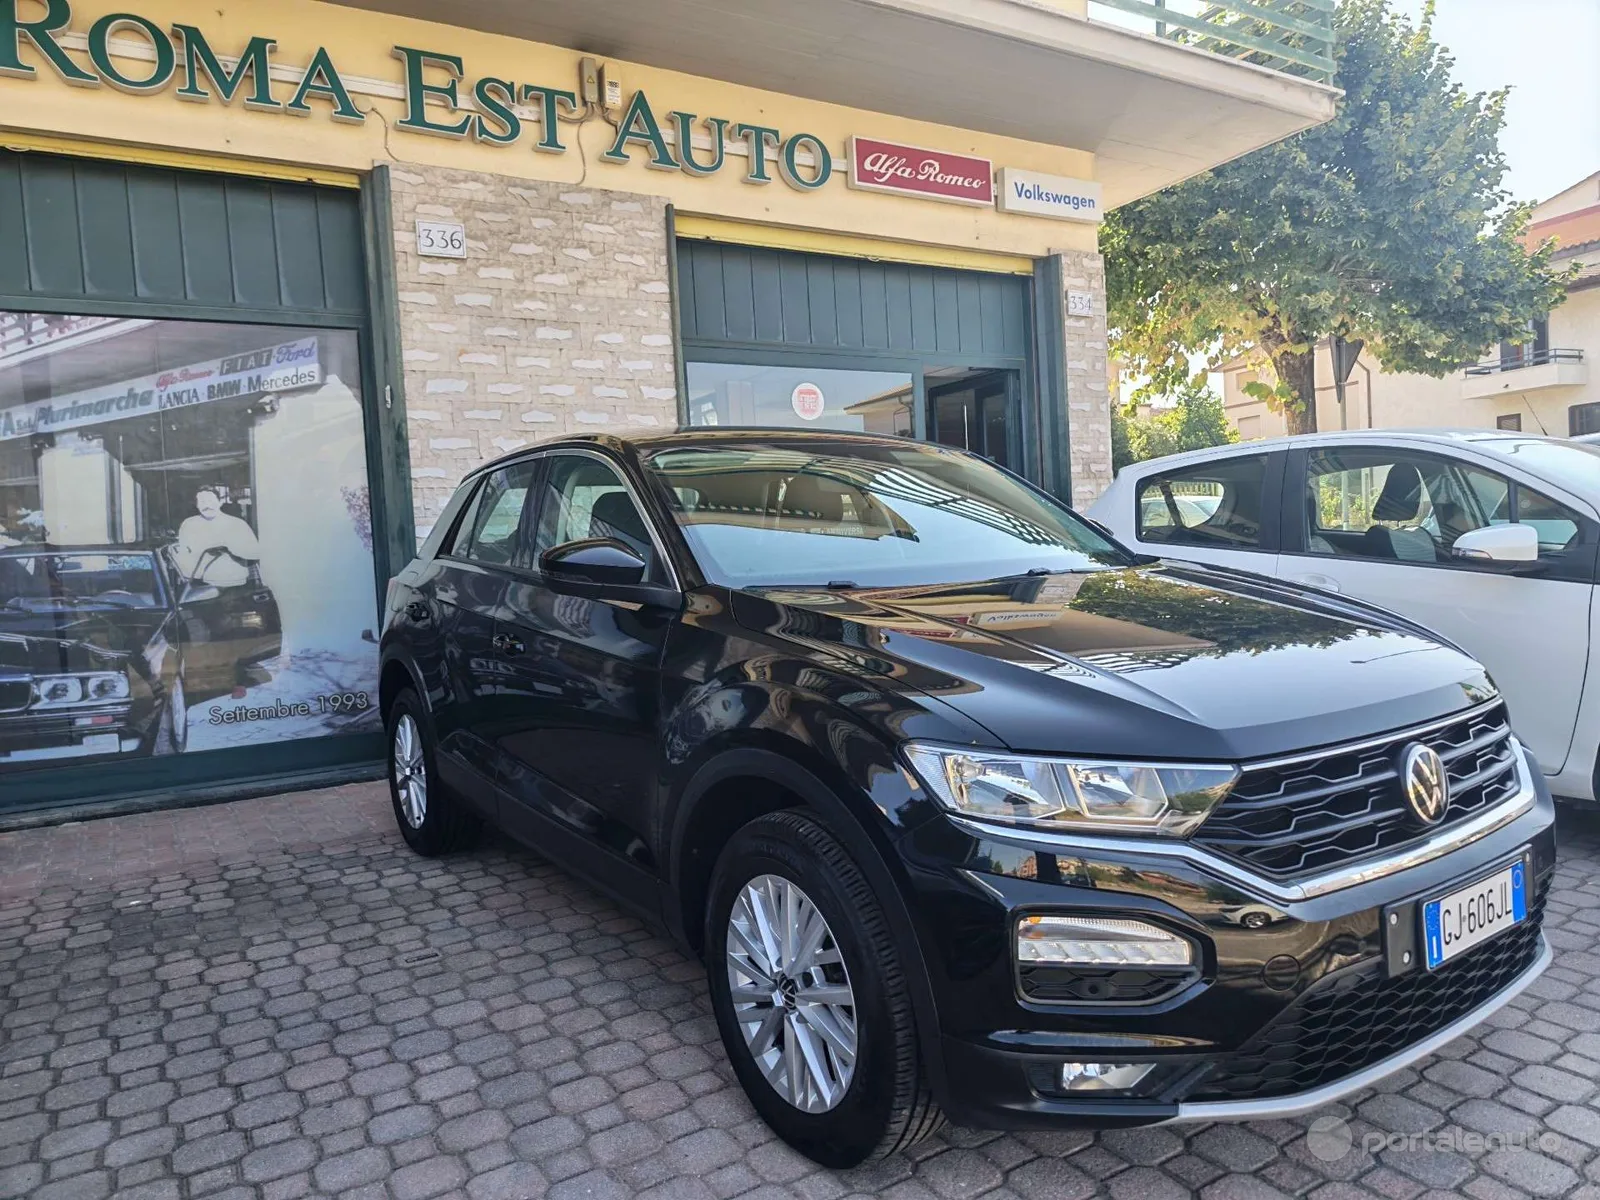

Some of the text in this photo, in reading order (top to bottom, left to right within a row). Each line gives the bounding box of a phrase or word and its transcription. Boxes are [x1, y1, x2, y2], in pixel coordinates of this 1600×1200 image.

[0, 0, 833, 191] ROMA EST AUTO
[863, 152, 987, 189] Alfa Romeo
[1014, 181, 1096, 211] Volkswagen
[422, 228, 463, 250] 336
[1070, 295, 1092, 311] 334
[221, 350, 272, 375] FIAT
[275, 341, 316, 364] Ford
[158, 367, 316, 410] LANCIA BMW Mercedes
[209, 690, 369, 725] Settembre 1993
